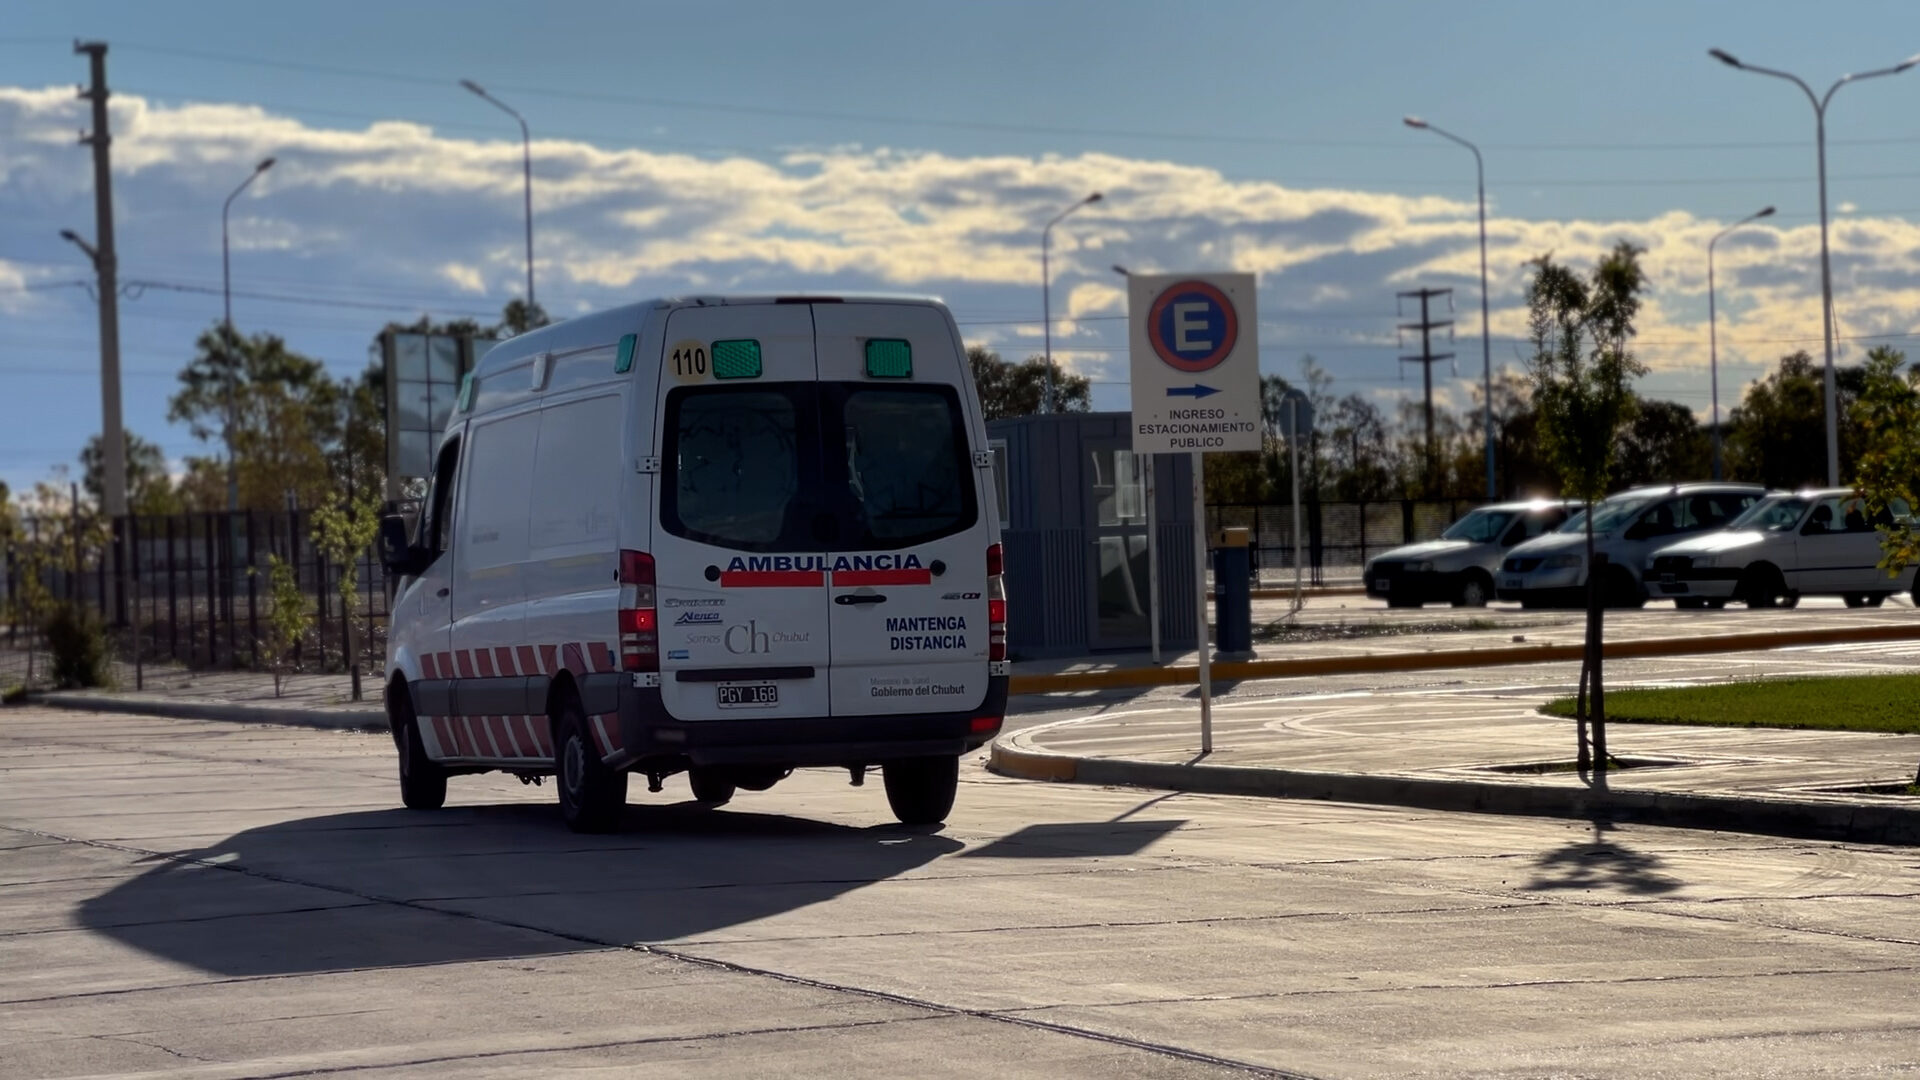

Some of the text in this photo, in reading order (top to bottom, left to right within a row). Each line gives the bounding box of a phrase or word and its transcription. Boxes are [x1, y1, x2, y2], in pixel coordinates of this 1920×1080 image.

[1174, 302, 1212, 352] E
[673, 348, 706, 375] 110
[1169, 408, 1225, 420] INGRESO
[1139, 422, 1255, 435] ESTACIONAMIENTO
[1170, 437, 1224, 448] PUBLICO
[727, 554, 922, 572] AMBULANCIA
[886, 616, 967, 632] MANTENGA
[686, 619, 810, 655] Somos Ch Chubut
[890, 635, 967, 650] DISTANCIA
[720, 686, 776, 702] PGY 168
[871, 683, 965, 697] Gobierno del Chubut
